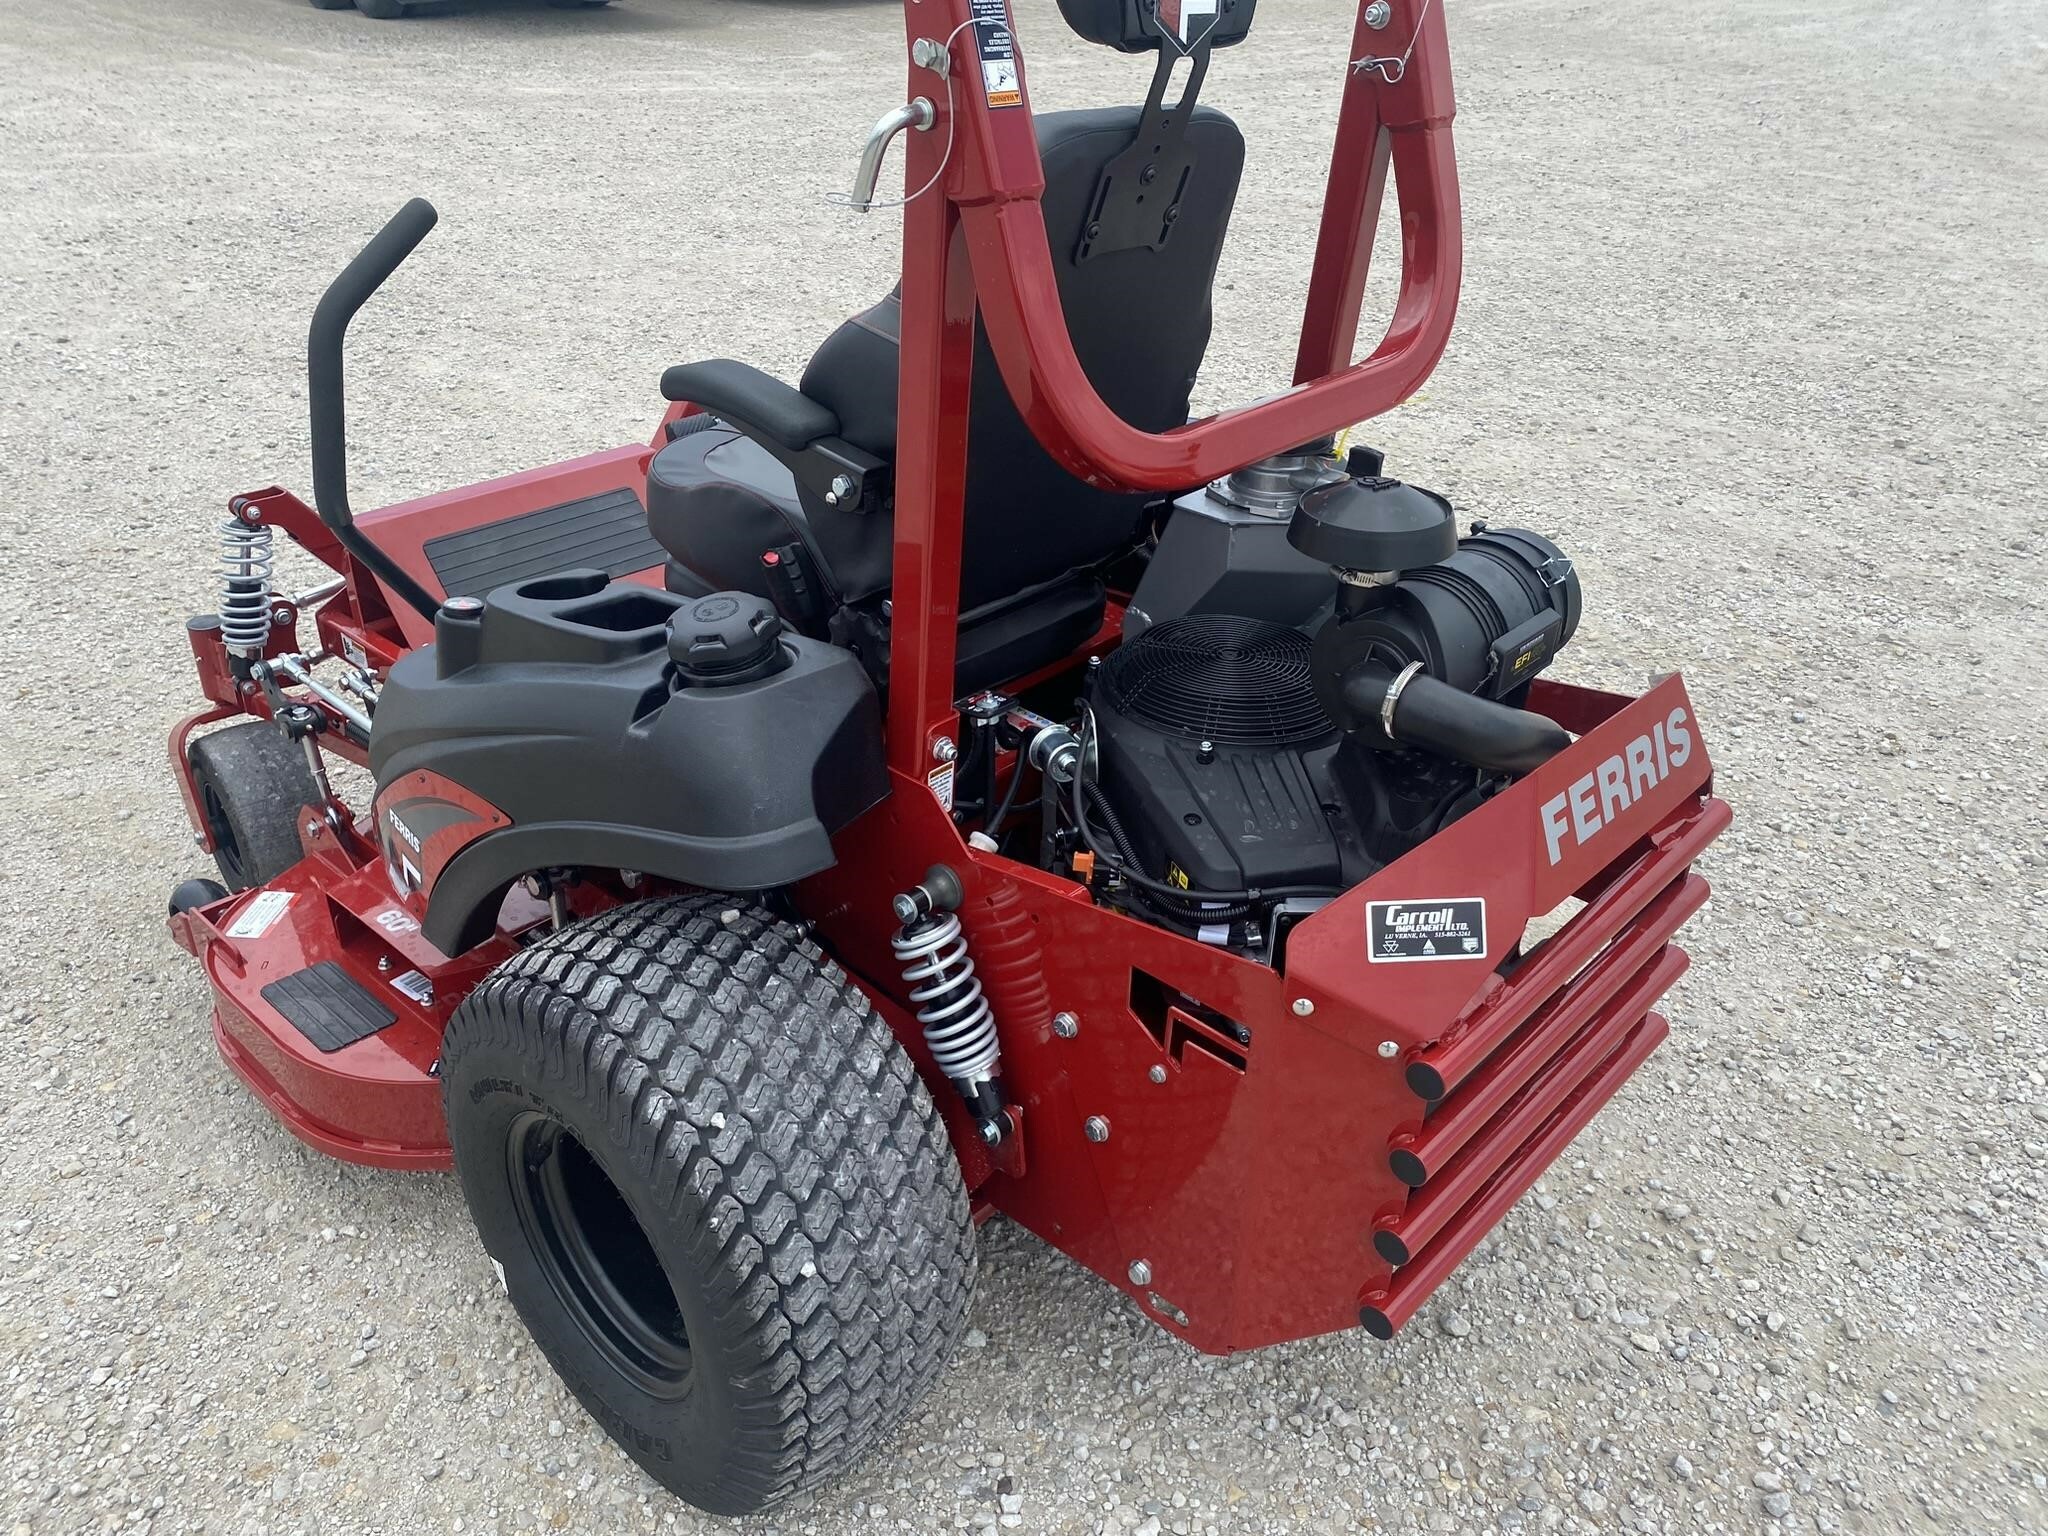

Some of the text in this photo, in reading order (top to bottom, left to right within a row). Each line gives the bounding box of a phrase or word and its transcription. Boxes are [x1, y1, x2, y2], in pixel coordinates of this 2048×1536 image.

[989, 94, 1015, 103] WARNING
[1514, 651, 1531, 669] EFI
[1540, 707, 1691, 866] FERRIS
[389, 808, 420, 853] FERRIS
[1386, 905, 1453, 931] Carroll
[1395, 922, 1469, 932] IMPLEMENT LTD.
